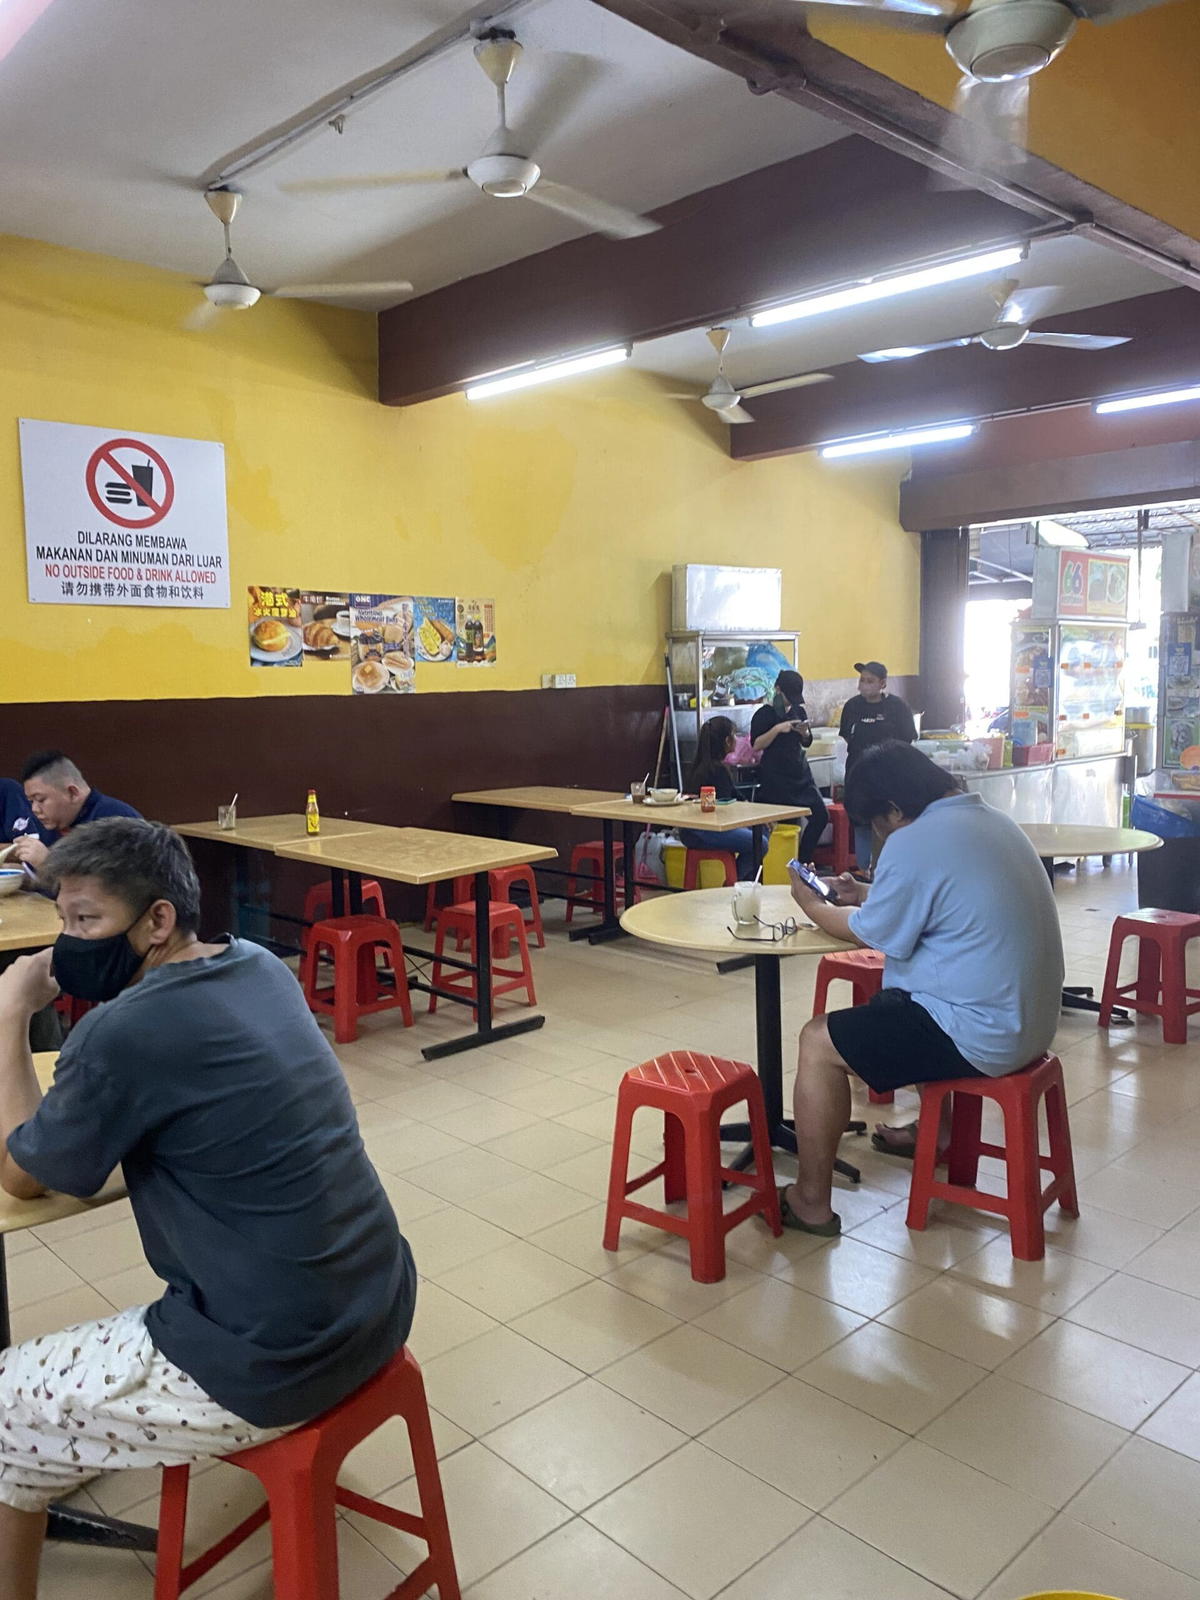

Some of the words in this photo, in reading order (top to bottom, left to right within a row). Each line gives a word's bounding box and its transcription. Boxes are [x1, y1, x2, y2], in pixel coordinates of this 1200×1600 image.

[77, 530, 133, 547] DILARANG
[135, 534, 187, 550] MEMBAWA
[36, 545, 93, 562] MAKANAN
[95, 548, 118, 563] DAN
[121, 550, 169, 566] MINUMAN
[171, 553, 194, 567] DARI
[197, 554, 222, 568] LUAR
[45, 563, 60, 577] NO
[62, 564, 105, 579] OUTSIDE
[107, 566, 134, 580] FOOD
[136, 568, 143, 581] &
[145, 568, 172, 582] DRINK
[175, 570, 216, 584] ALLOWED
[61, 581, 204, 599] 请勿携带外面食物和饮料
[260, 592, 289, 607] 港式
